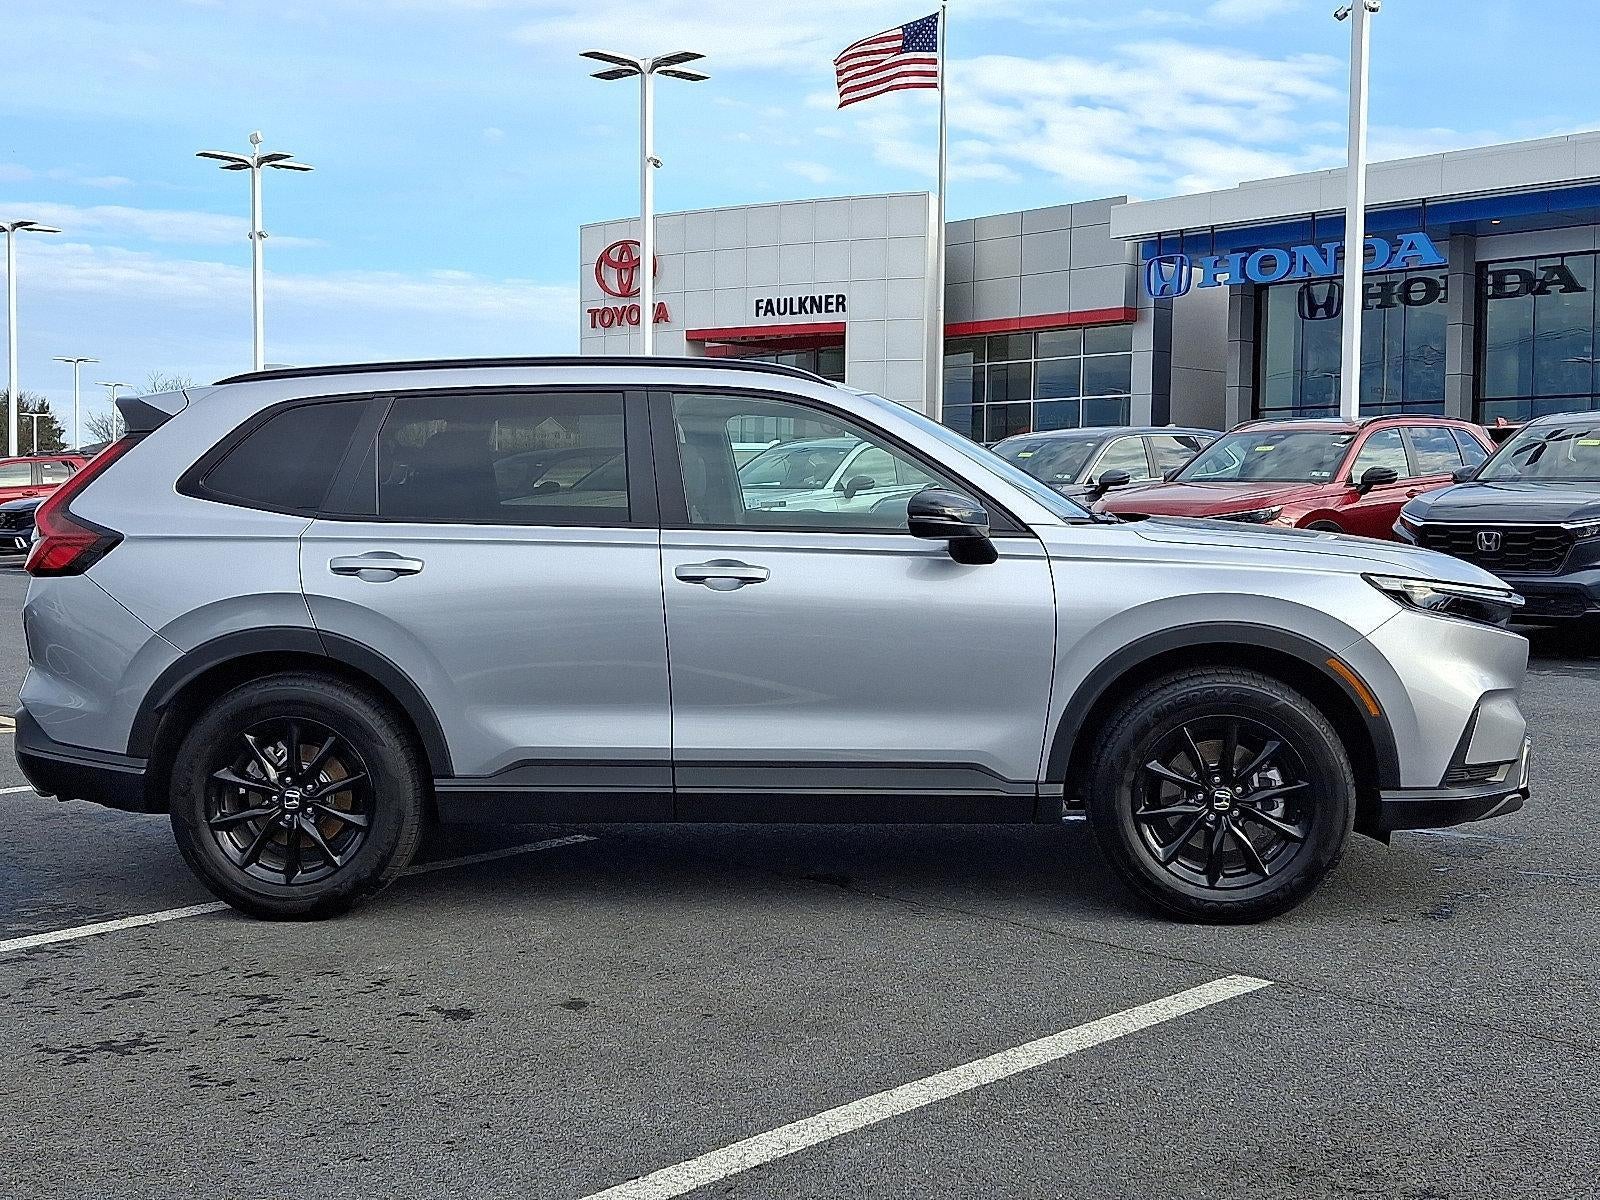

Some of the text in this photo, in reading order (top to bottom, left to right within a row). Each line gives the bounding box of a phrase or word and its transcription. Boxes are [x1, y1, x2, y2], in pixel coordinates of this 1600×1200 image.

[1197, 231, 1448, 289] HONDA
[755, 294, 847, 317] FAULKNER
[1362, 264, 1587, 311] HODA
[587, 301, 670, 329] TOYOA
